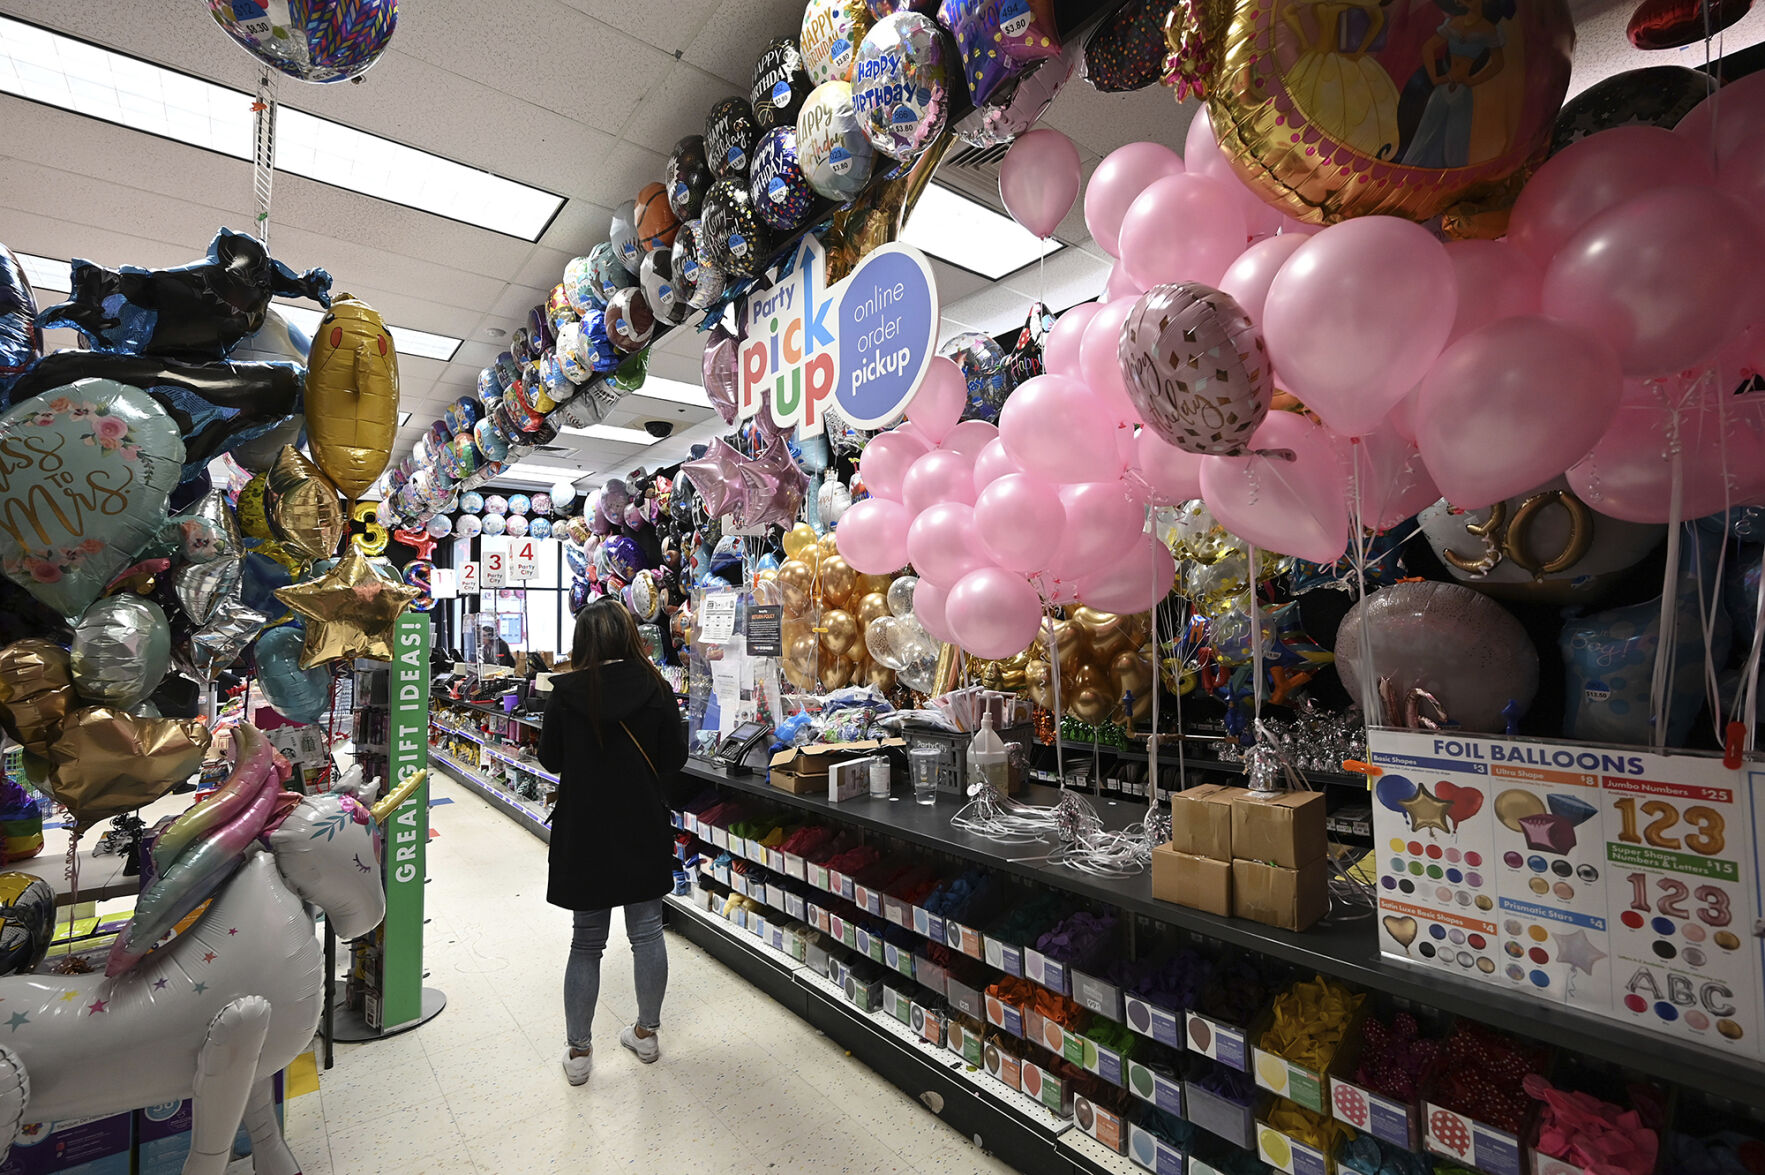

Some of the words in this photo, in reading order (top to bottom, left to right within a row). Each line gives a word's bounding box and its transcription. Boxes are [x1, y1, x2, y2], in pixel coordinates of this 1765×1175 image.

[246, 22, 269, 34] $8.30
[800, 7, 833, 56] HAPPY
[1005, 18, 1026, 35] $3.80
[895, 124, 913, 133] $3.80
[833, 162, 849, 172] $3.80
[753, 283, 795, 325] Party
[854, 283, 905, 323] online
[743, 246, 835, 408] pick
[857, 315, 903, 352] order
[852, 347, 911, 397] pickup
[44, 471, 74, 489] TO
[519, 542, 534, 561] 4
[489, 554, 502, 571] 3
[464, 565, 475, 579] 2
[400, 623, 422, 711] IDEAS!
[1374, 755, 1391, 763] Basic
[1392, 756, 1417, 766] Shapes
[1433, 740, 1485, 760] FOIL
[1490, 745, 1645, 775] BALLOONS
[1473, 764, 1485, 773] $3
[1495, 768, 1517, 777] Ultra
[1517, 768, 1545, 780] Shape
[1580, 775, 1594, 786] $8
[1607, 780, 1640, 791] Jumbo
[1641, 783, 1689, 796] Numbers
[1701, 788, 1729, 801] $25
[1613, 797, 1726, 856] 123
[1611, 845, 1643, 857] Super
[1644, 849, 1677, 862] Shape
[1611, 852, 1660, 866] Numbers
[1662, 860, 1672, 868] &
[1673, 863, 1710, 874] Letters
[1706, 860, 1733, 874] $15
[1626, 872, 1732, 928] 123
[1381, 901, 1399, 910] Satin
[1399, 903, 1416, 915] Luxe
[1417, 908, 1436, 919] Basic
[1436, 912, 1464, 927] Shapes
[1504, 900, 1547, 917] Prismatic
[1548, 910, 1574, 922] Stars
[1482, 922, 1495, 934] $4
[1590, 917, 1604, 930] $4
[1624, 966, 1737, 1018] ABC
